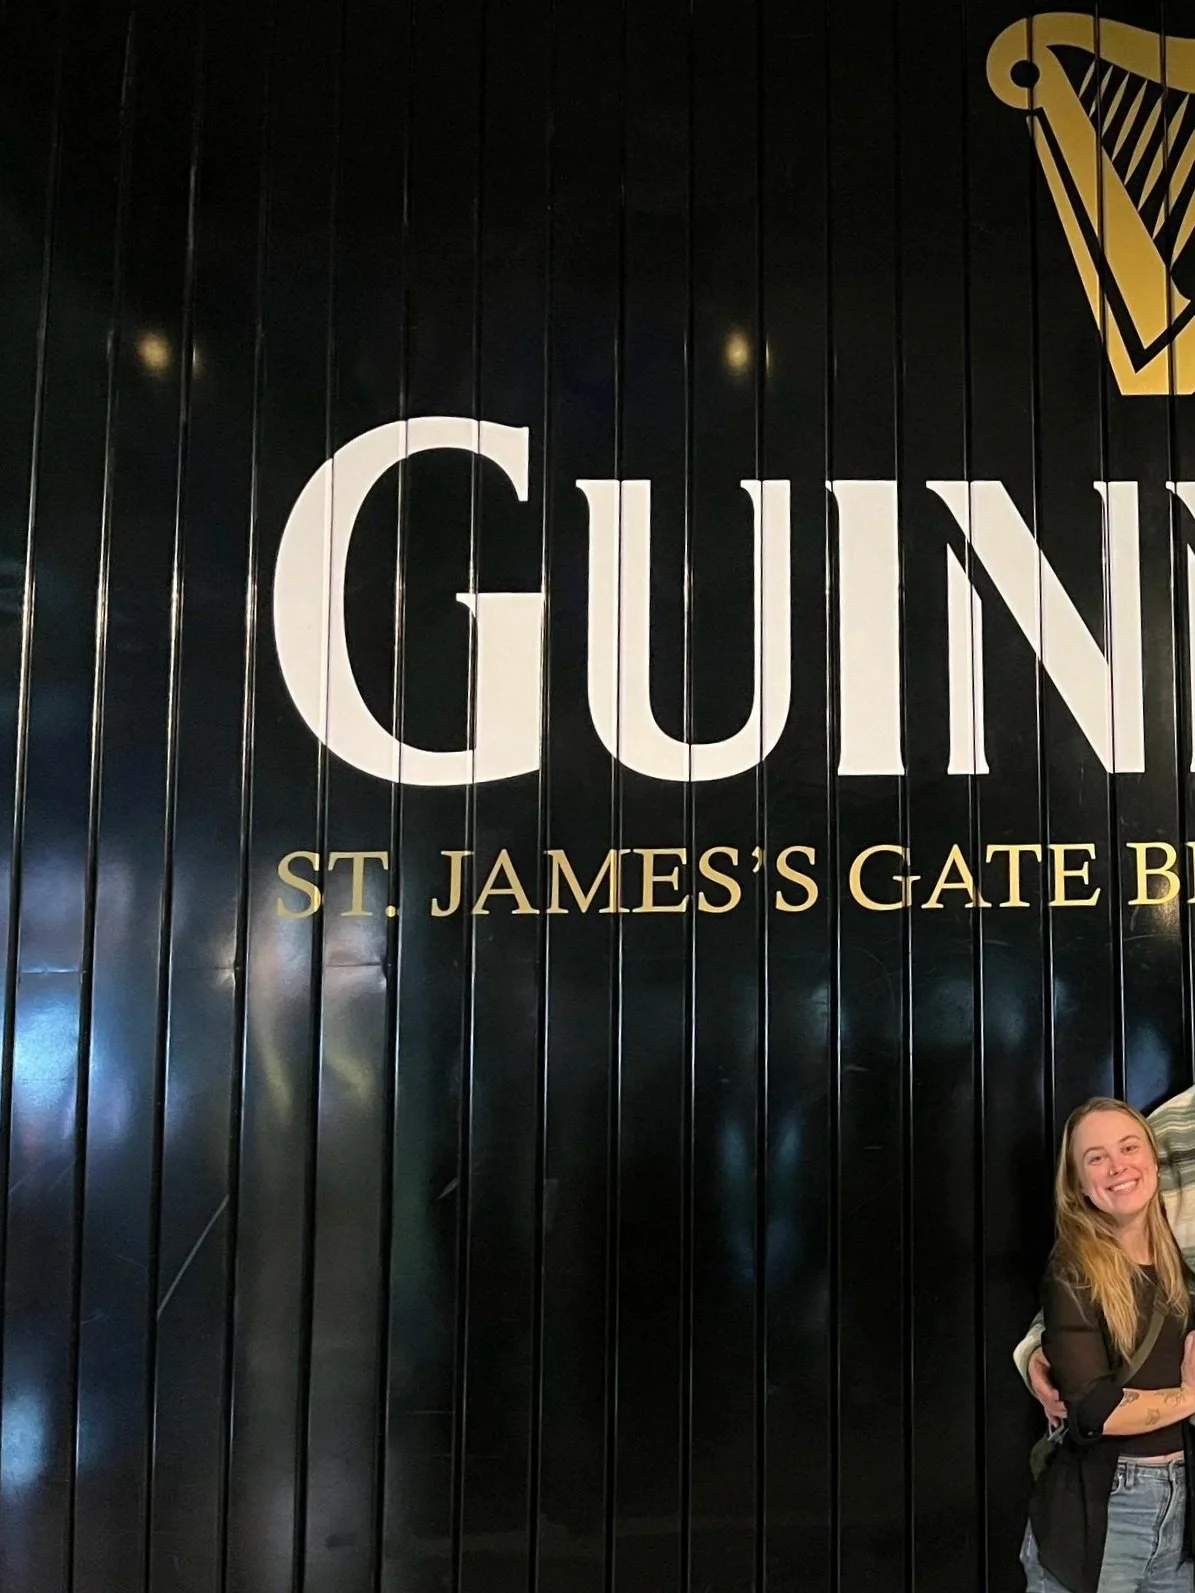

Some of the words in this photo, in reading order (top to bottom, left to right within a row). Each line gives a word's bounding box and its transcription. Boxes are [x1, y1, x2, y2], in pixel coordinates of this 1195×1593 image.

[275, 849, 398, 919] ST.
[430, 844, 820, 917] JAMES’S
[848, 841, 1103, 913] GATE
